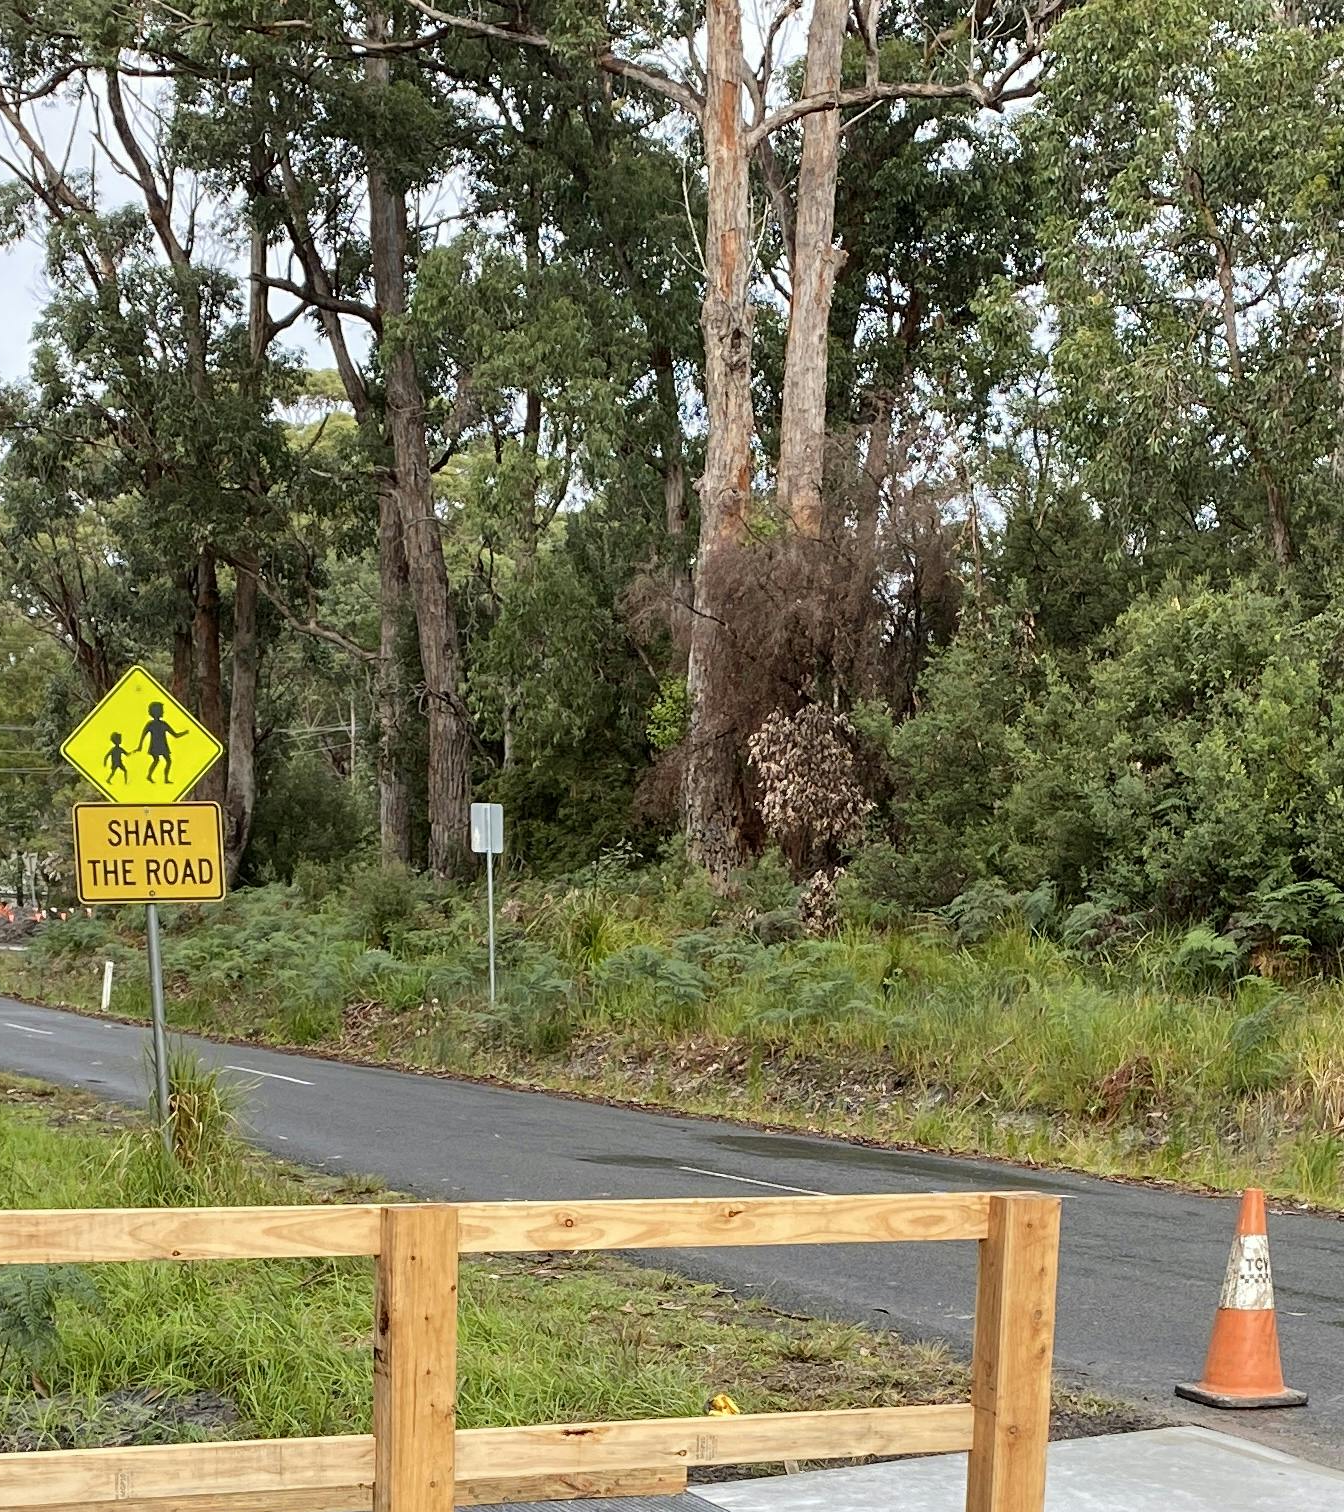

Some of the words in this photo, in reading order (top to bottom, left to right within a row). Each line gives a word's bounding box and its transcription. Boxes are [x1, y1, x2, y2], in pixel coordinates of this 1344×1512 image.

[107, 819, 192, 847] SHARE
[87, 859, 136, 886] THE
[145, 858, 213, 886] ROAD
